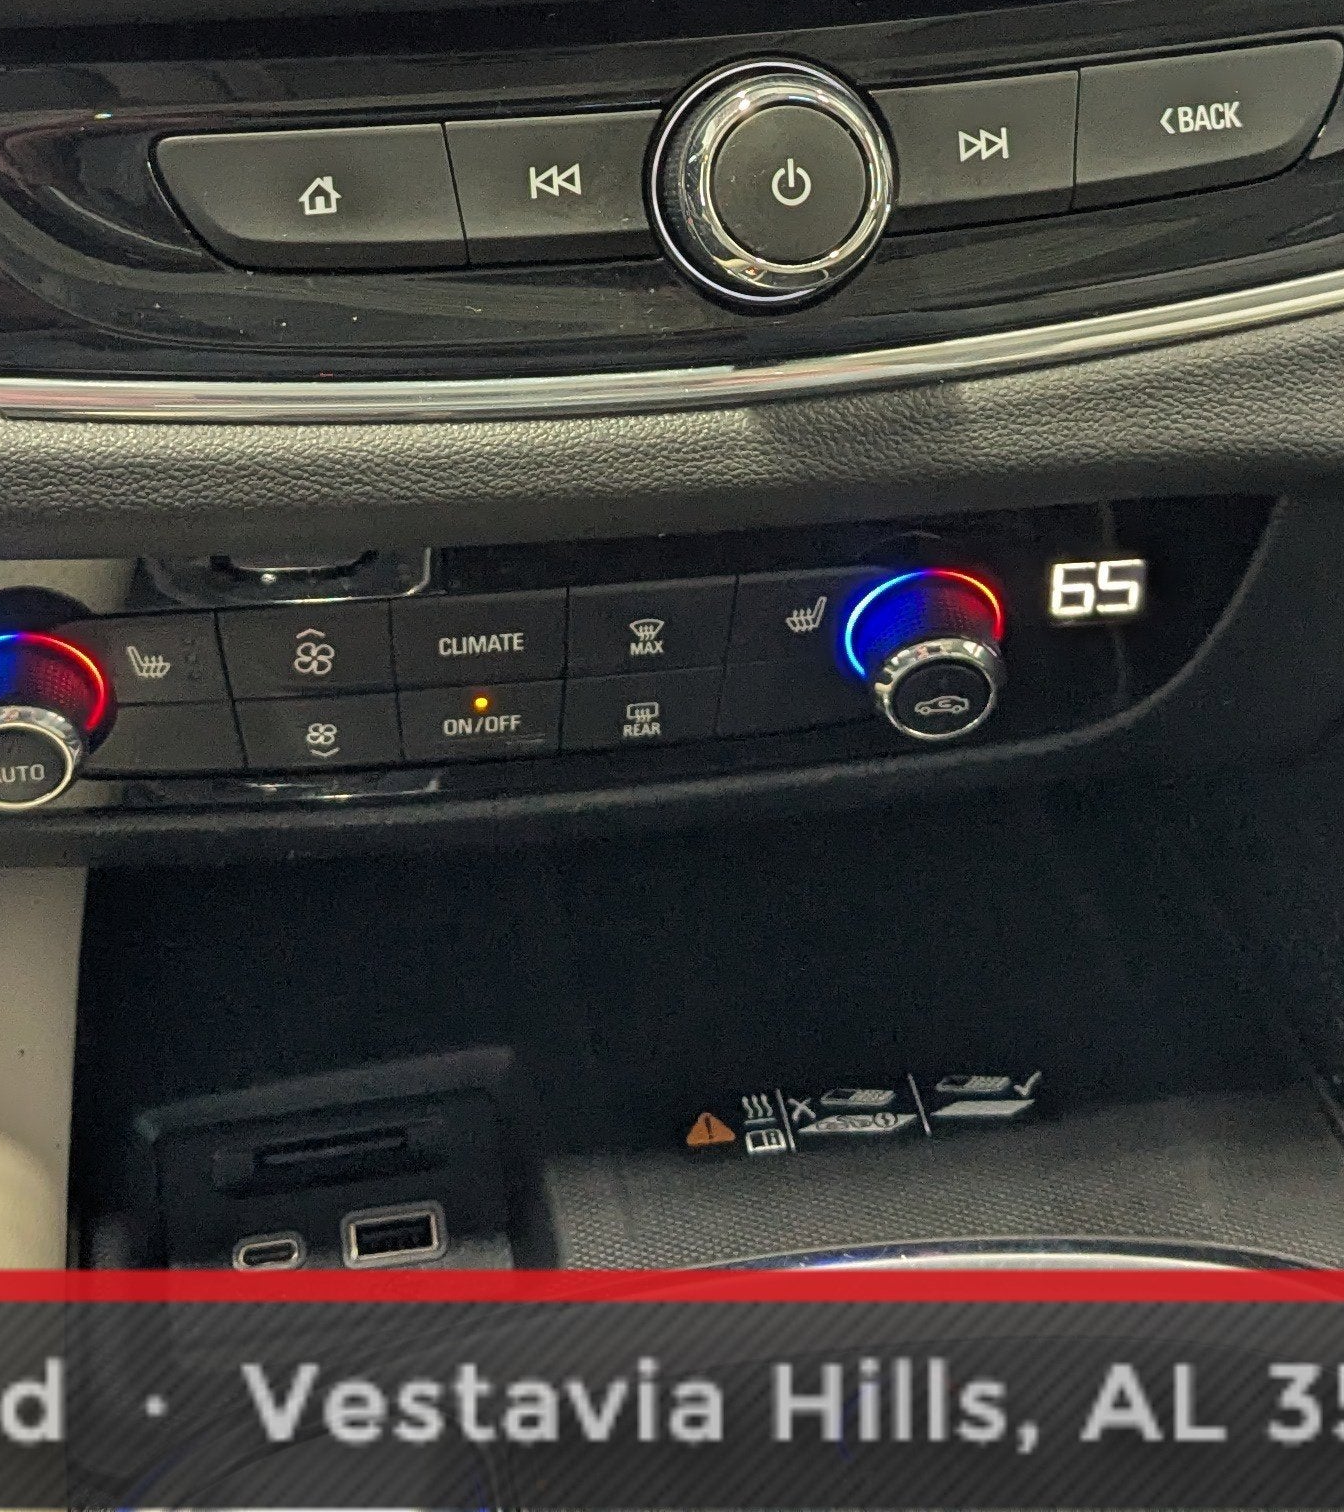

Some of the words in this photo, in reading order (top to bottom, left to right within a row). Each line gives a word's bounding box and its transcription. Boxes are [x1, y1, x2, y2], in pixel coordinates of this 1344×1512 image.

[1051, 557, 1147, 617] 65
[438, 631, 525, 657] CLIMATE
[630, 639, 664, 656] MAX
[443, 715, 522, 737] ON/OFF
[622, 722, 662, 738] REAR
